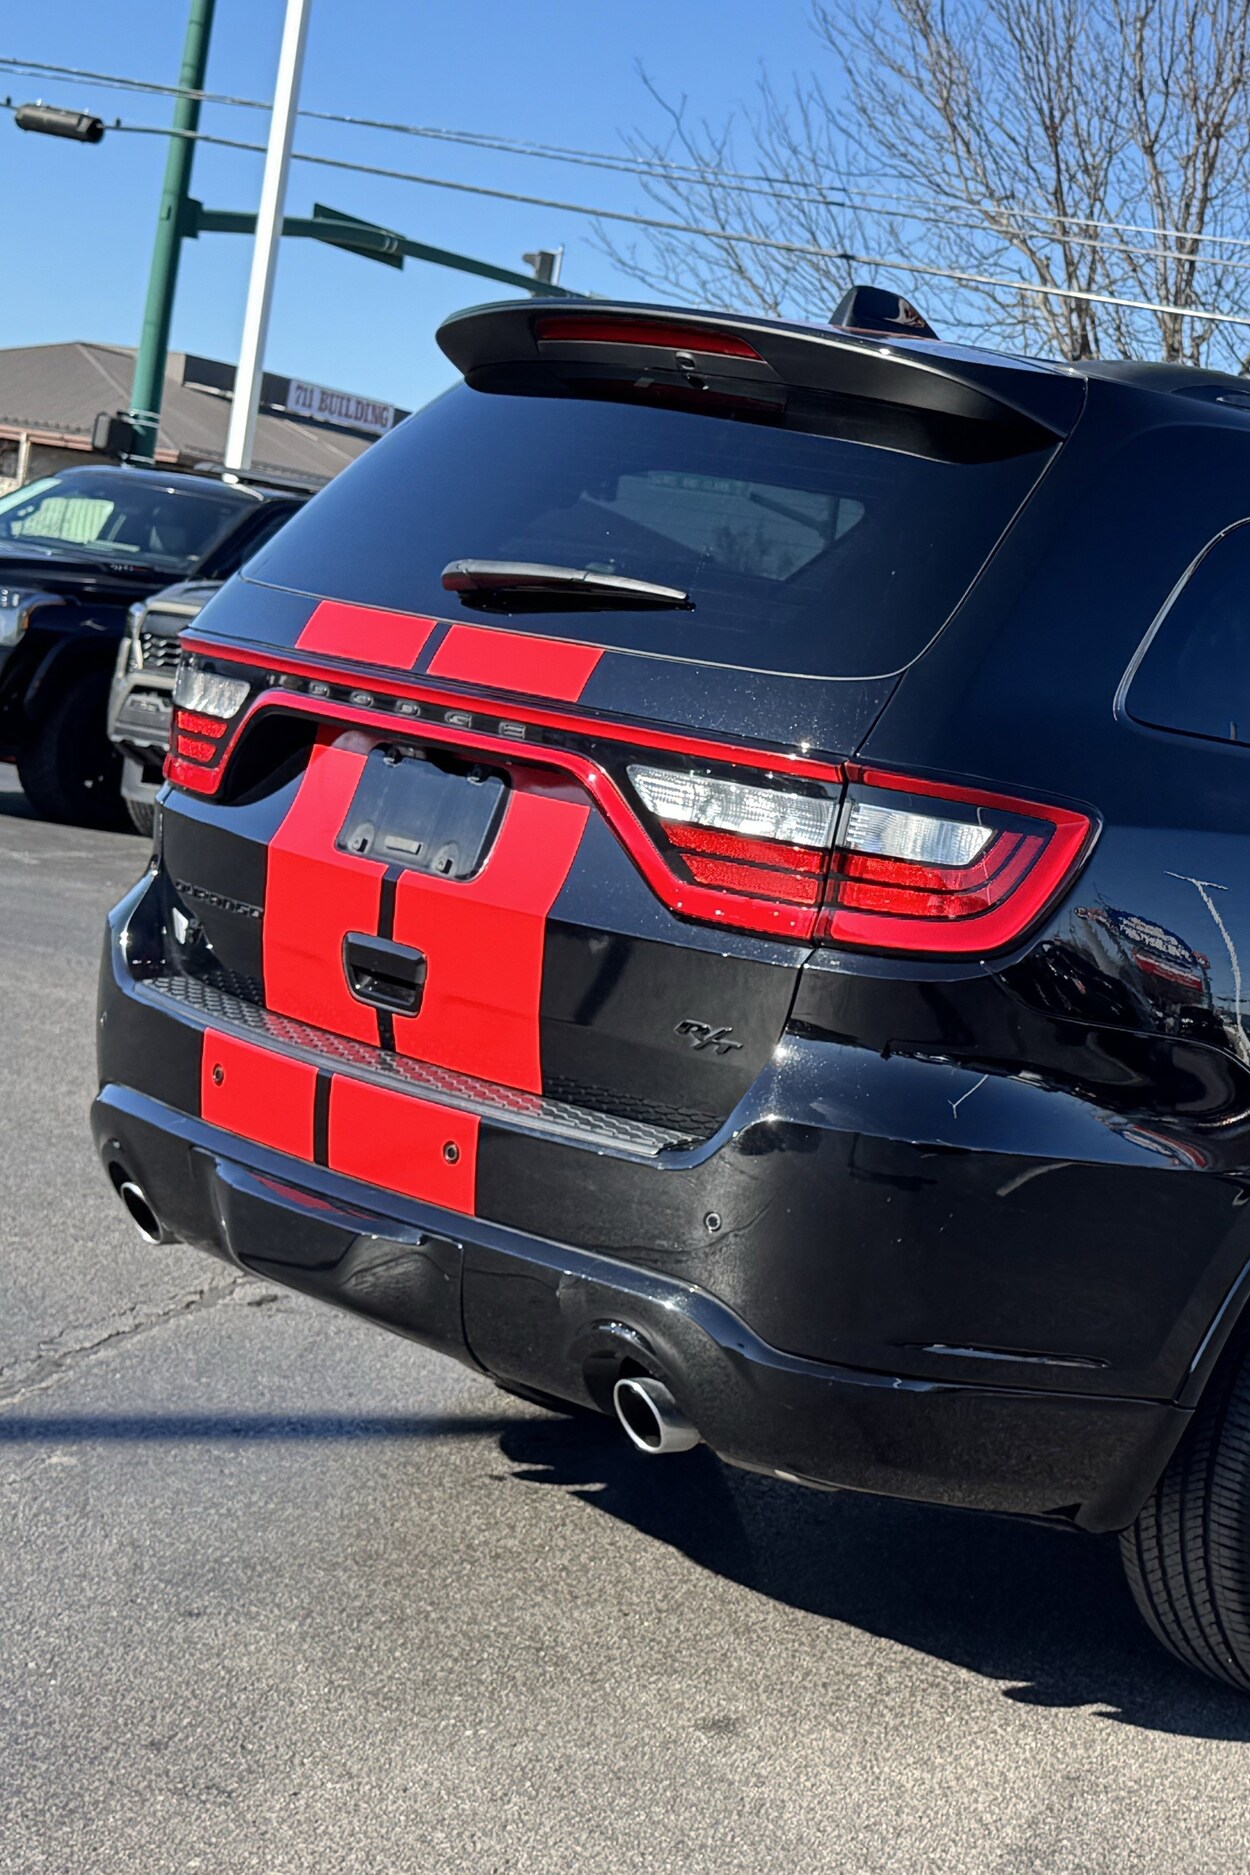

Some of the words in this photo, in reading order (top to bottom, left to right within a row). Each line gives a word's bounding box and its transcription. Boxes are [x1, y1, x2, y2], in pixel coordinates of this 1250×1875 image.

[295, 384, 314, 410] 711
[317, 389, 390, 429] BUILDING
[307, 680, 527, 738] DODGE
[673, 1019, 744, 1055] R/T
